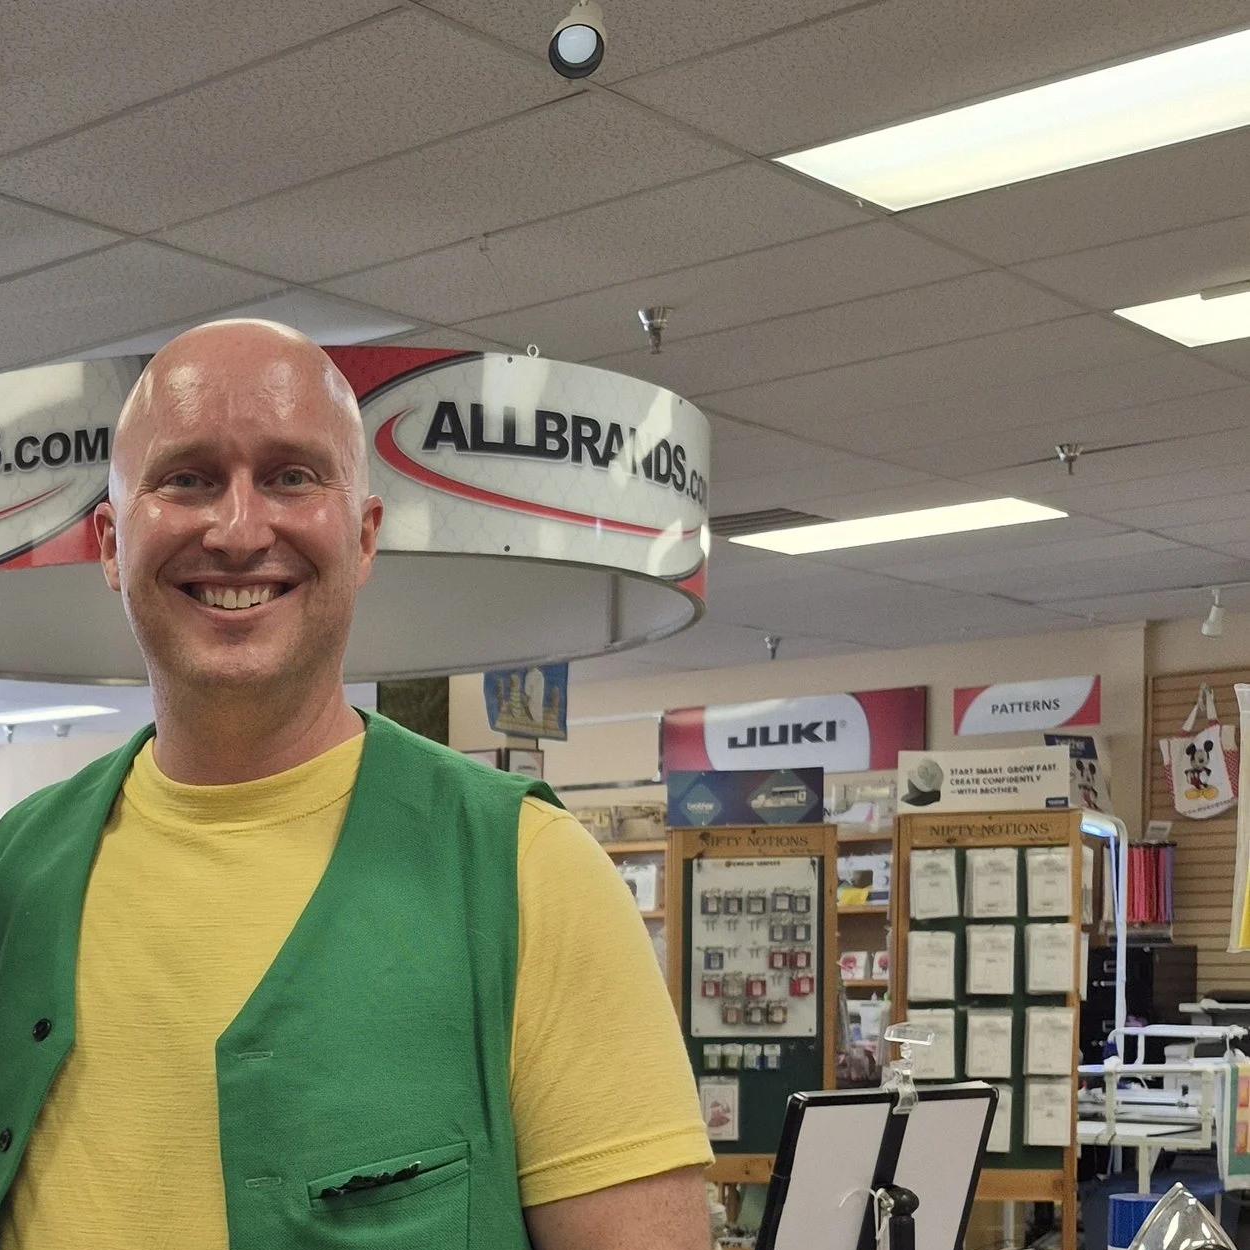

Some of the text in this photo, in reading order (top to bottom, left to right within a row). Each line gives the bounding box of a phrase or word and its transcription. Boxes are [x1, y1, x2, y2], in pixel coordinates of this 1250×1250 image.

[991, 699, 1060, 716] PATTERNS
[728, 720, 837, 749] JUKI
[1007, 765, 1034, 774] GROW
[950, 775, 1041, 786] CREATE CONFIDENTLY
[930, 823, 1049, 837] NIFTY NOTIONS
[747, 836, 808, 847] NOTIONS
